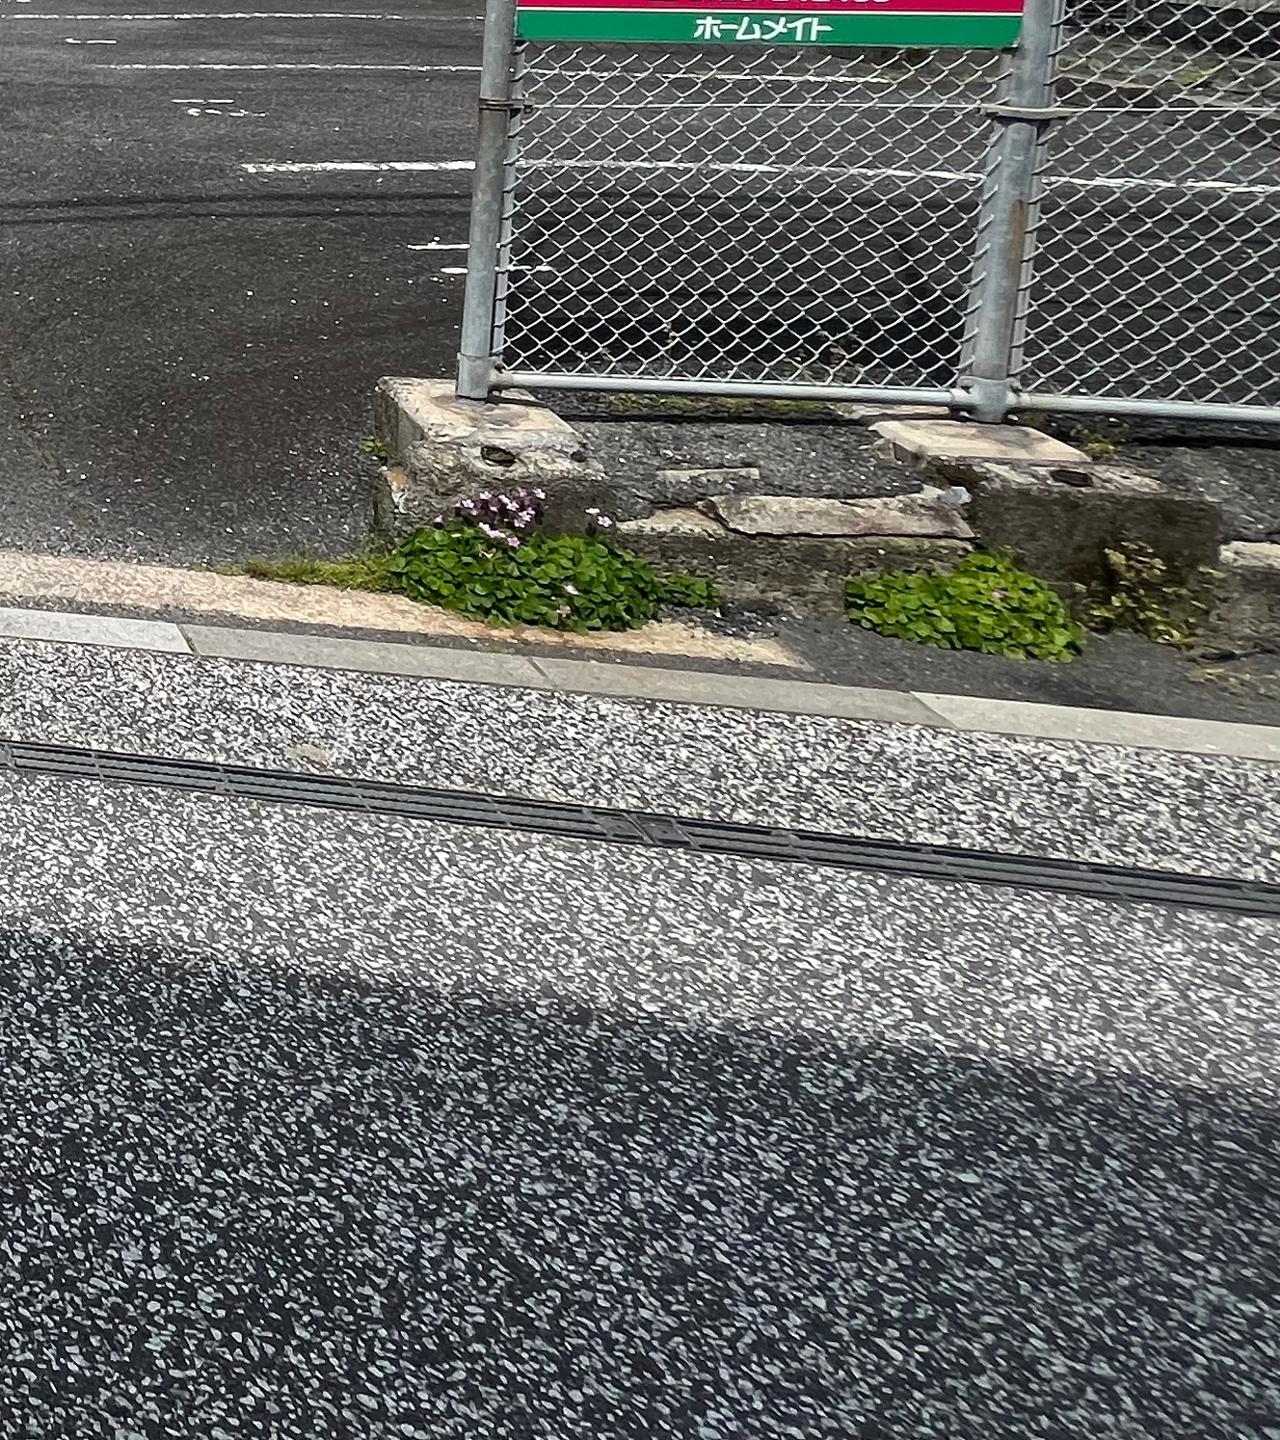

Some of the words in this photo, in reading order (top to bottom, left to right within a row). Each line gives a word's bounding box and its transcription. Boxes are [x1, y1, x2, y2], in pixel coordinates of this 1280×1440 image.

[693, 16, 833, 41] ホームメイト
